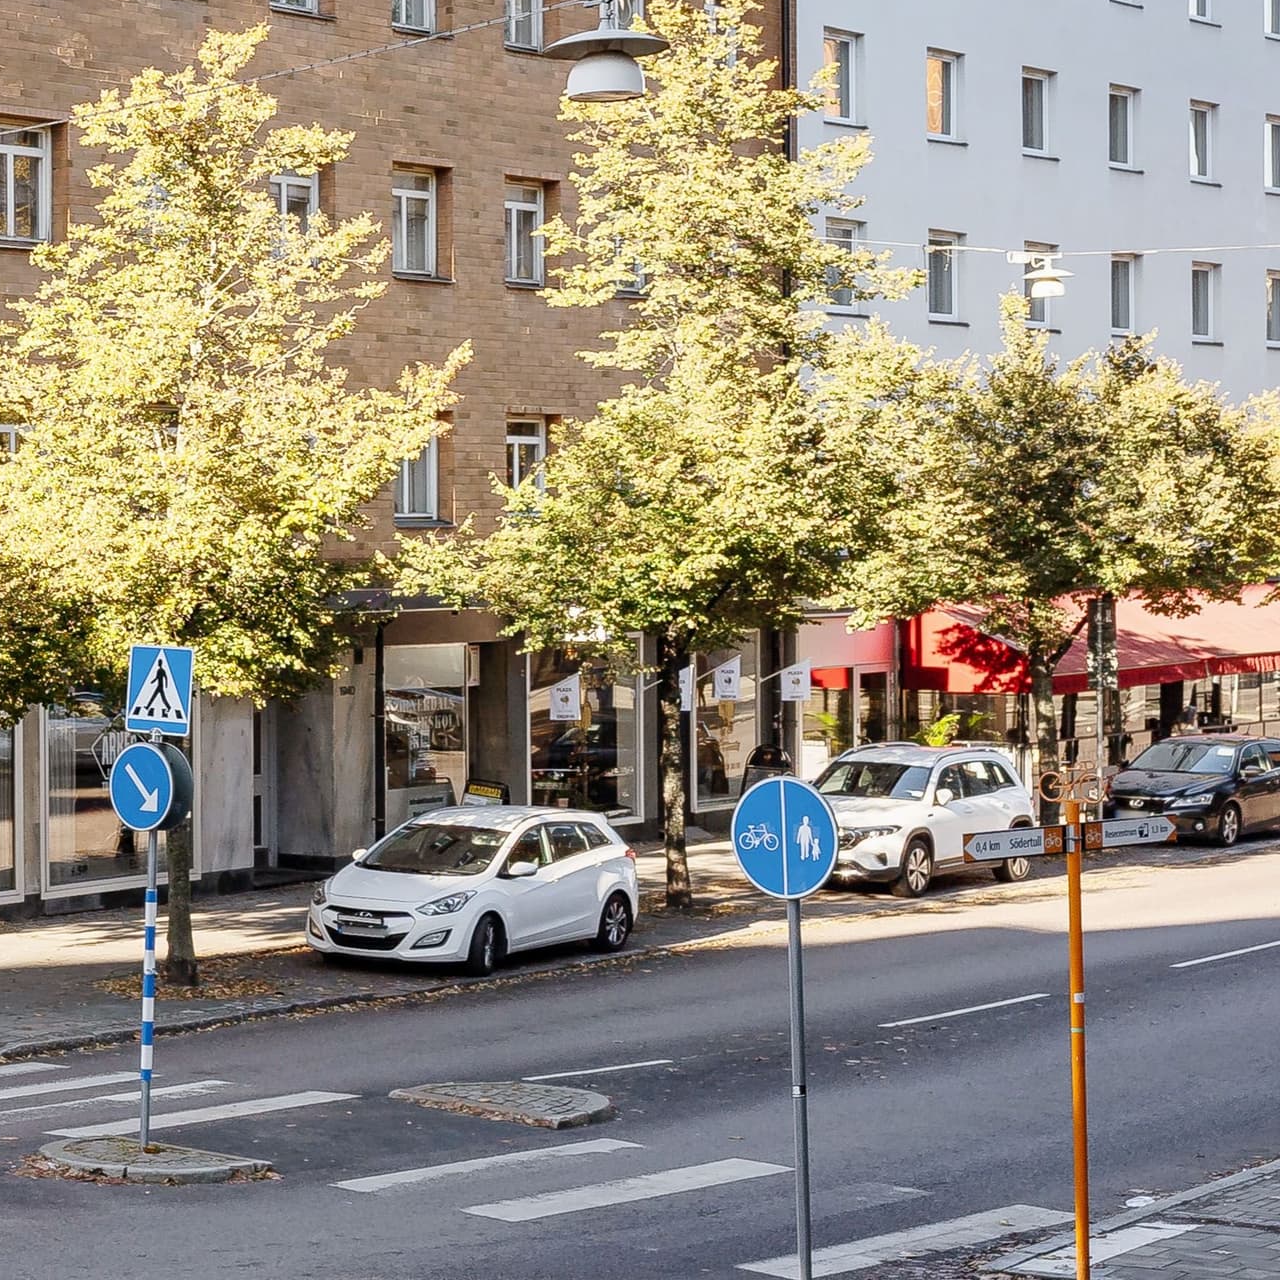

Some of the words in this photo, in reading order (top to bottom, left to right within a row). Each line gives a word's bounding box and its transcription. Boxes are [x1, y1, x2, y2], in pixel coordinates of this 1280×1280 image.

[975, 840, 988, 853] 0,4
[989, 840, 1001, 851] km
[1009, 835, 1041, 849] Södertull
